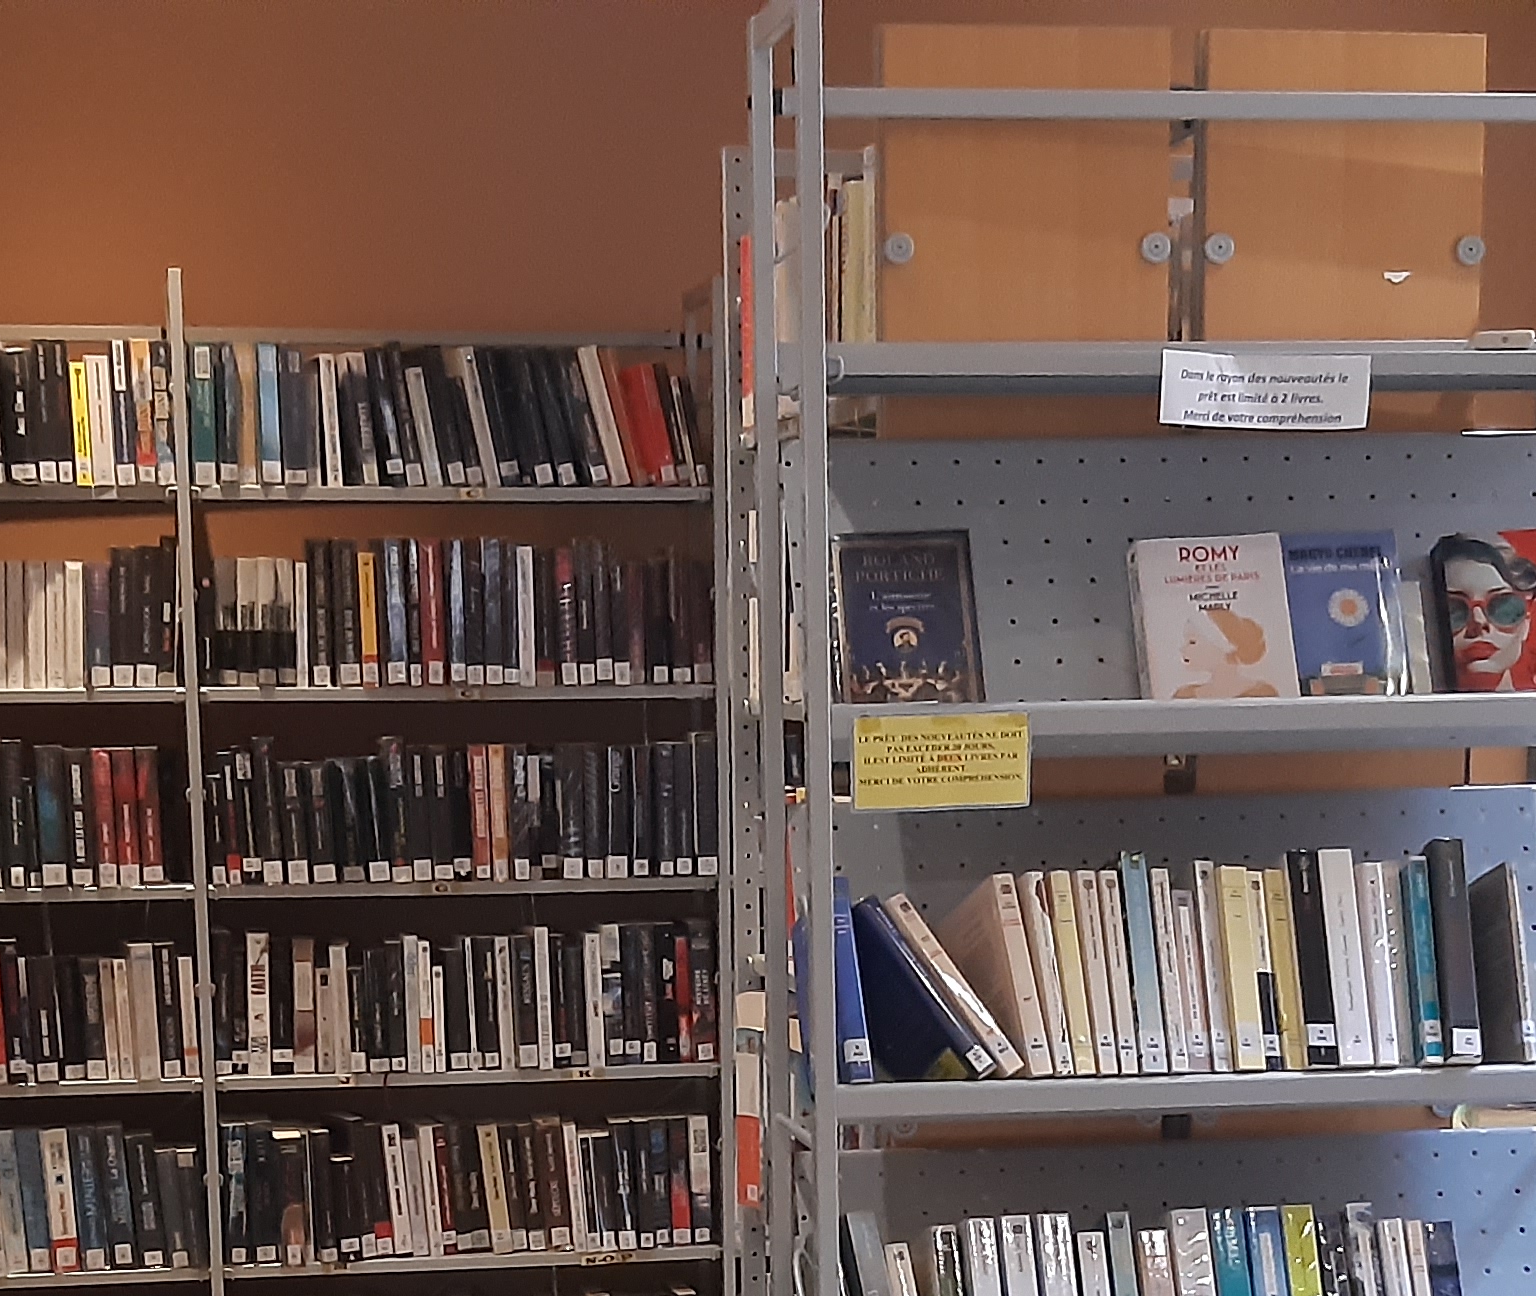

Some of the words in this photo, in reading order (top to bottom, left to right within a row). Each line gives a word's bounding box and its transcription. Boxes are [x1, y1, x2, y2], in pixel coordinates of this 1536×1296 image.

[1206, 370, 1215, 381] le
[1216, 372, 1245, 385] rayon
[1248, 372, 1266, 383] des
[1269, 372, 1335, 384] nouveautés
[1338, 373, 1349, 384] le
[1197, 392, 1218, 402] prêt
[1220, 393, 1235, 402] est
[1281, 393, 1287, 403] 2
[1290, 393, 1324, 404] livres.
[1212, 412, 1225, 422] de
[1228, 413, 1254, 423] votre
[1257, 413, 1342, 425] compréhension
[1179, 545, 1239, 562] ROMY
[578, 1069, 592, 1079] K
